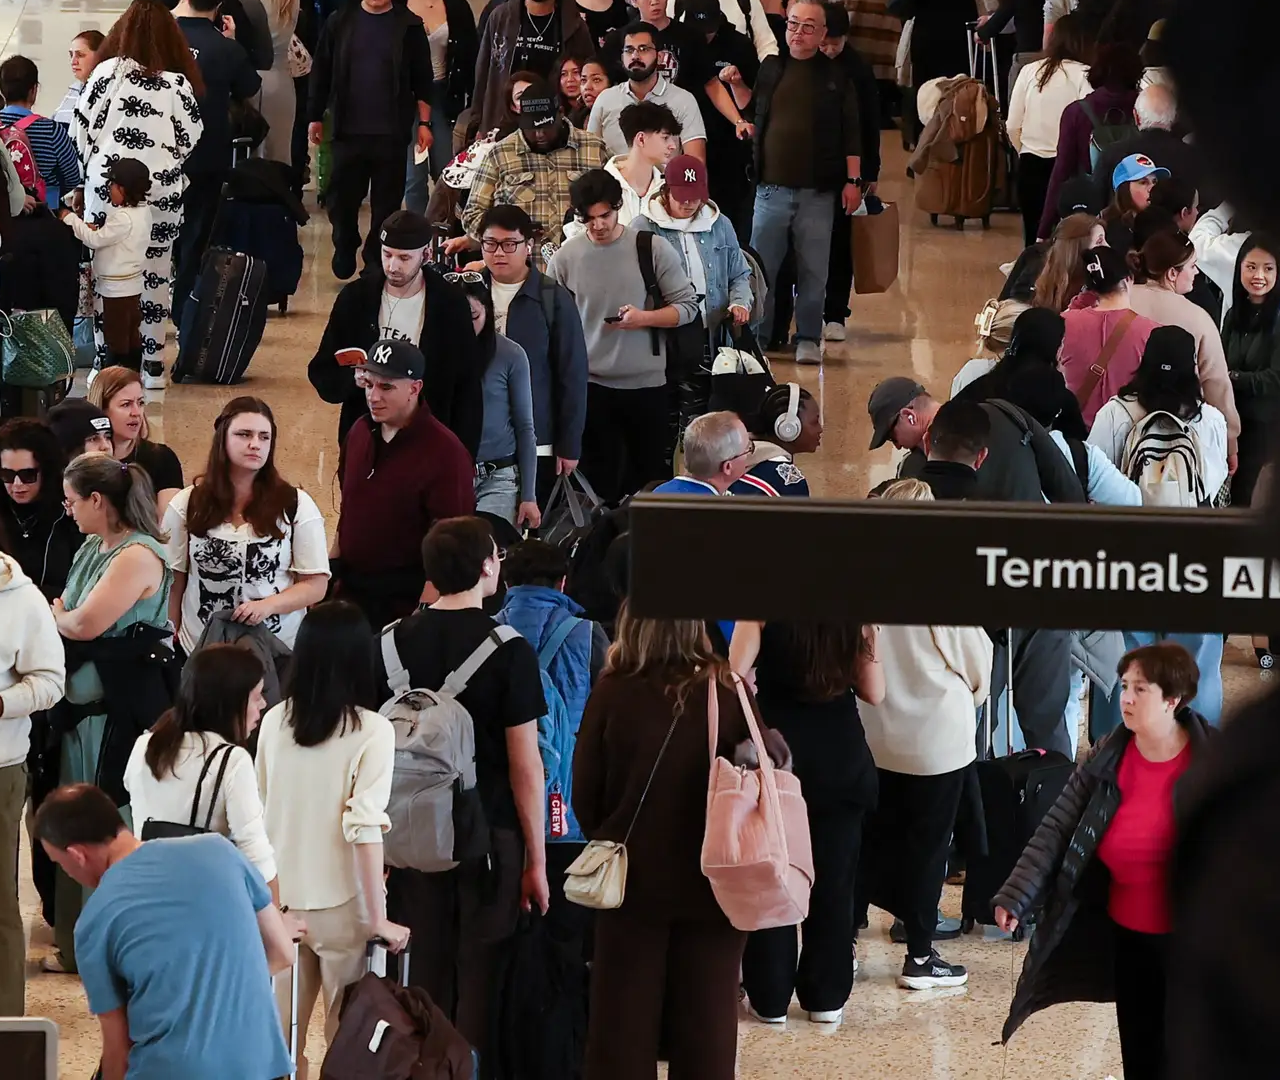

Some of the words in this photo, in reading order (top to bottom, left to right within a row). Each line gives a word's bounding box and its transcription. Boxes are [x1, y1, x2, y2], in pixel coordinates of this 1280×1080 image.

[684, 168, 697, 182] NY
[373, 344, 392, 364] NY
[976, 546, 1209, 594] Terminals
[551, 800, 560, 832] CREW
